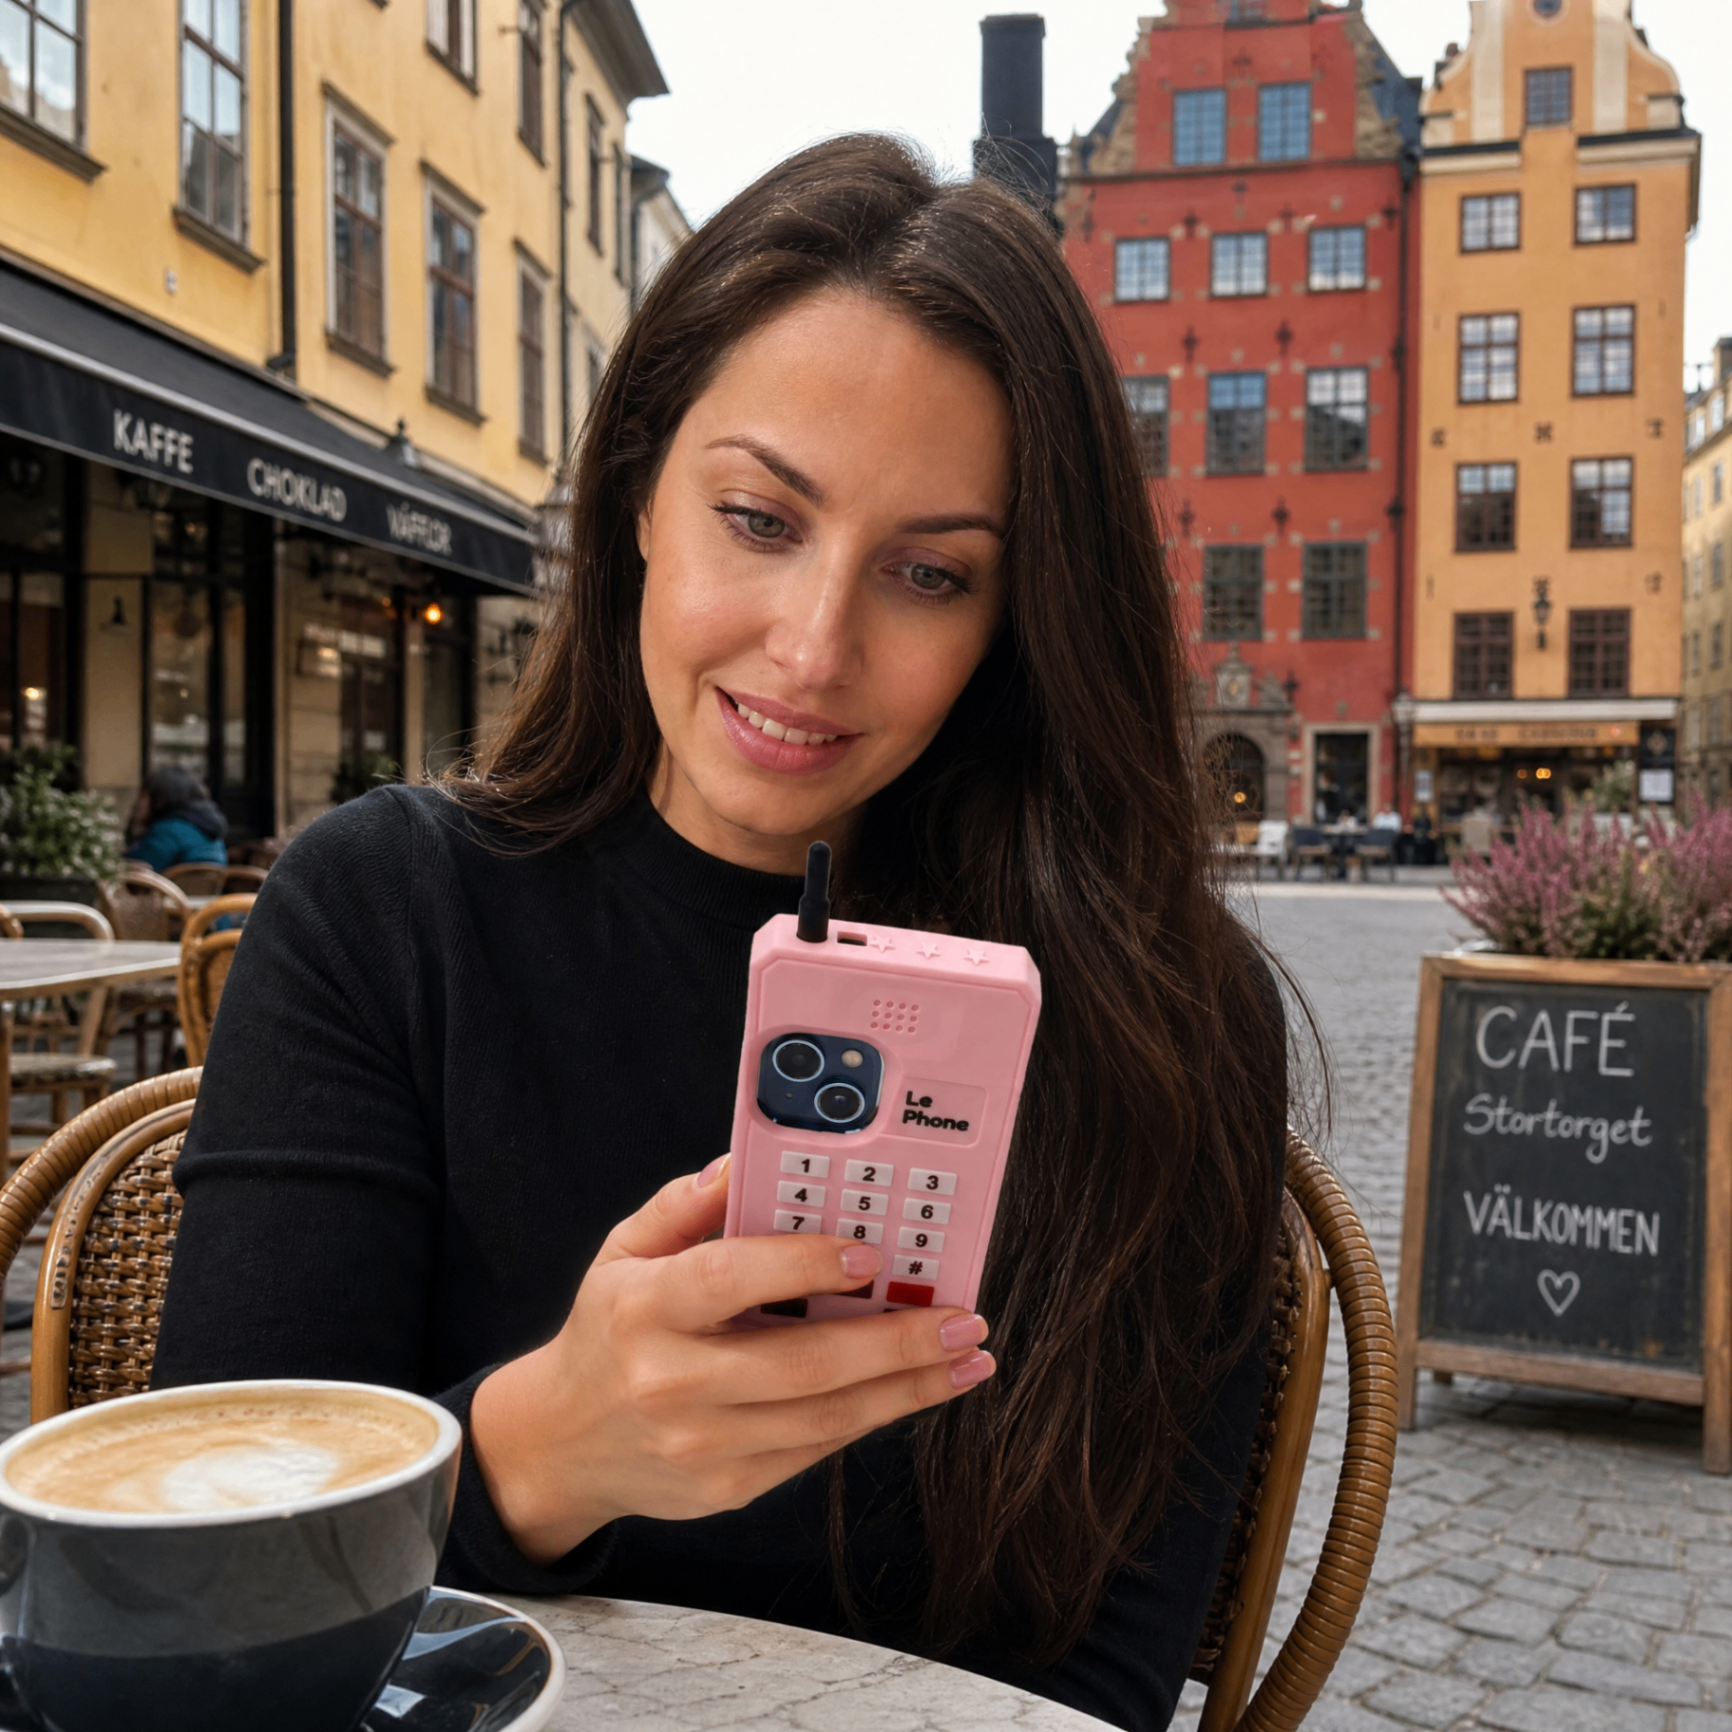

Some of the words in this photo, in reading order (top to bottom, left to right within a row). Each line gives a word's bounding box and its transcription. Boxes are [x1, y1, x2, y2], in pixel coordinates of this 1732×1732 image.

[113, 409, 194, 474] KAFFE
[247, 457, 347, 522] CHOKLAD
[1476, 1000, 1636, 1077] CAFÉ
[905, 1090, 933, 1108] Le
[902, 1109, 970, 1132] Phone
[1463, 1092, 1653, 1165] Stortorget
[801, 1158, 811, 1173] 1
[862, 1166, 877, 1183] 2
[925, 1174, 939, 1191] 3
[794, 1188, 808, 1203] 4
[858, 1196, 871, 1211] 5
[920, 1204, 934, 1220] 6
[1463, 1183, 1661, 1257] VÄLKOMMEN
[792, 1215, 805, 1231] 7
[852, 1224, 867, 1240] 8
[915, 1233, 928, 1248] 9
[908, 1260, 923, 1276] #
